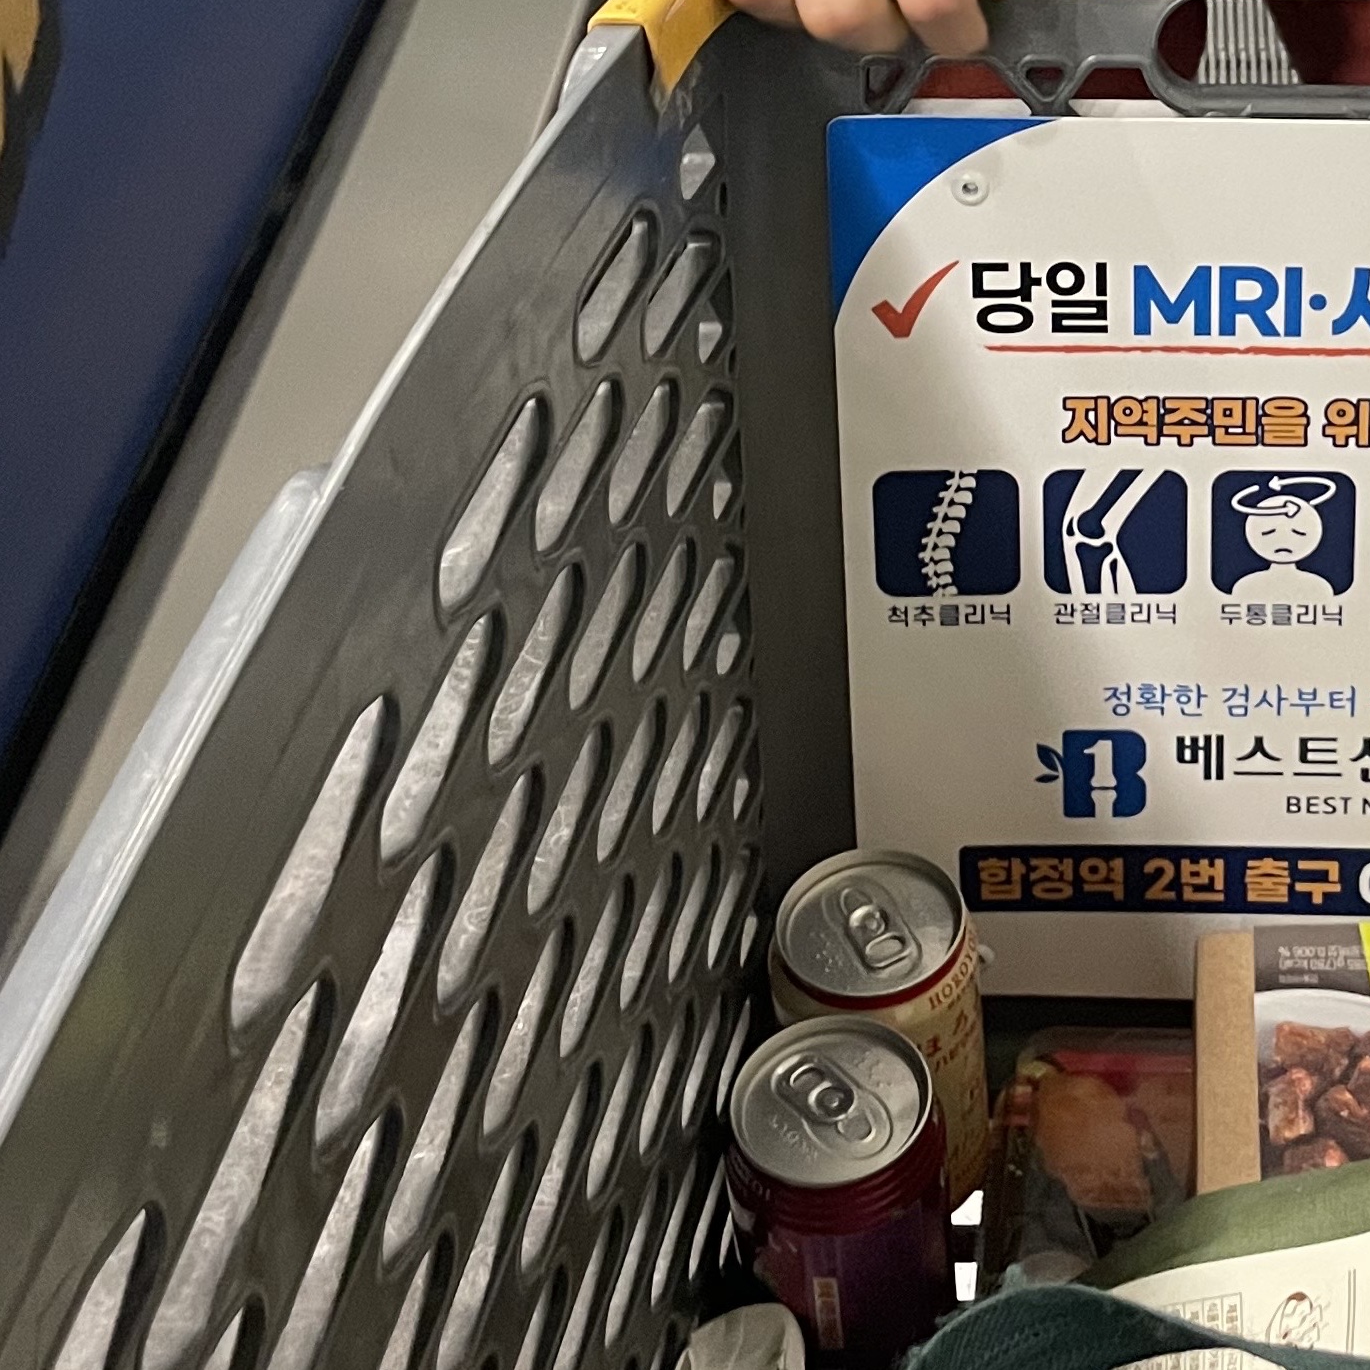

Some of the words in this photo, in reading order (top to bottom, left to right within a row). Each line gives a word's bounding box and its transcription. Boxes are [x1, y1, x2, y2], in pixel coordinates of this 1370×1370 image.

[971, 261, 1109, 334] 당일
[1061, 396, 1310, 447] 지역주민을
[886, 603, 1012, 627] 척추클리닉
[1053, 602, 1178, 625] 관절클리닉
[1219, 603, 1344, 627] 두통클리닉
[1103, 683, 1208, 717] 정확한
[1222, 684, 1357, 718] 검사부터
[1286, 795, 1352, 815] BEST
[977, 857, 1125, 901] 합정역
[1143, 857, 1226, 902] 2번
[1244, 857, 1342, 905] 출구
